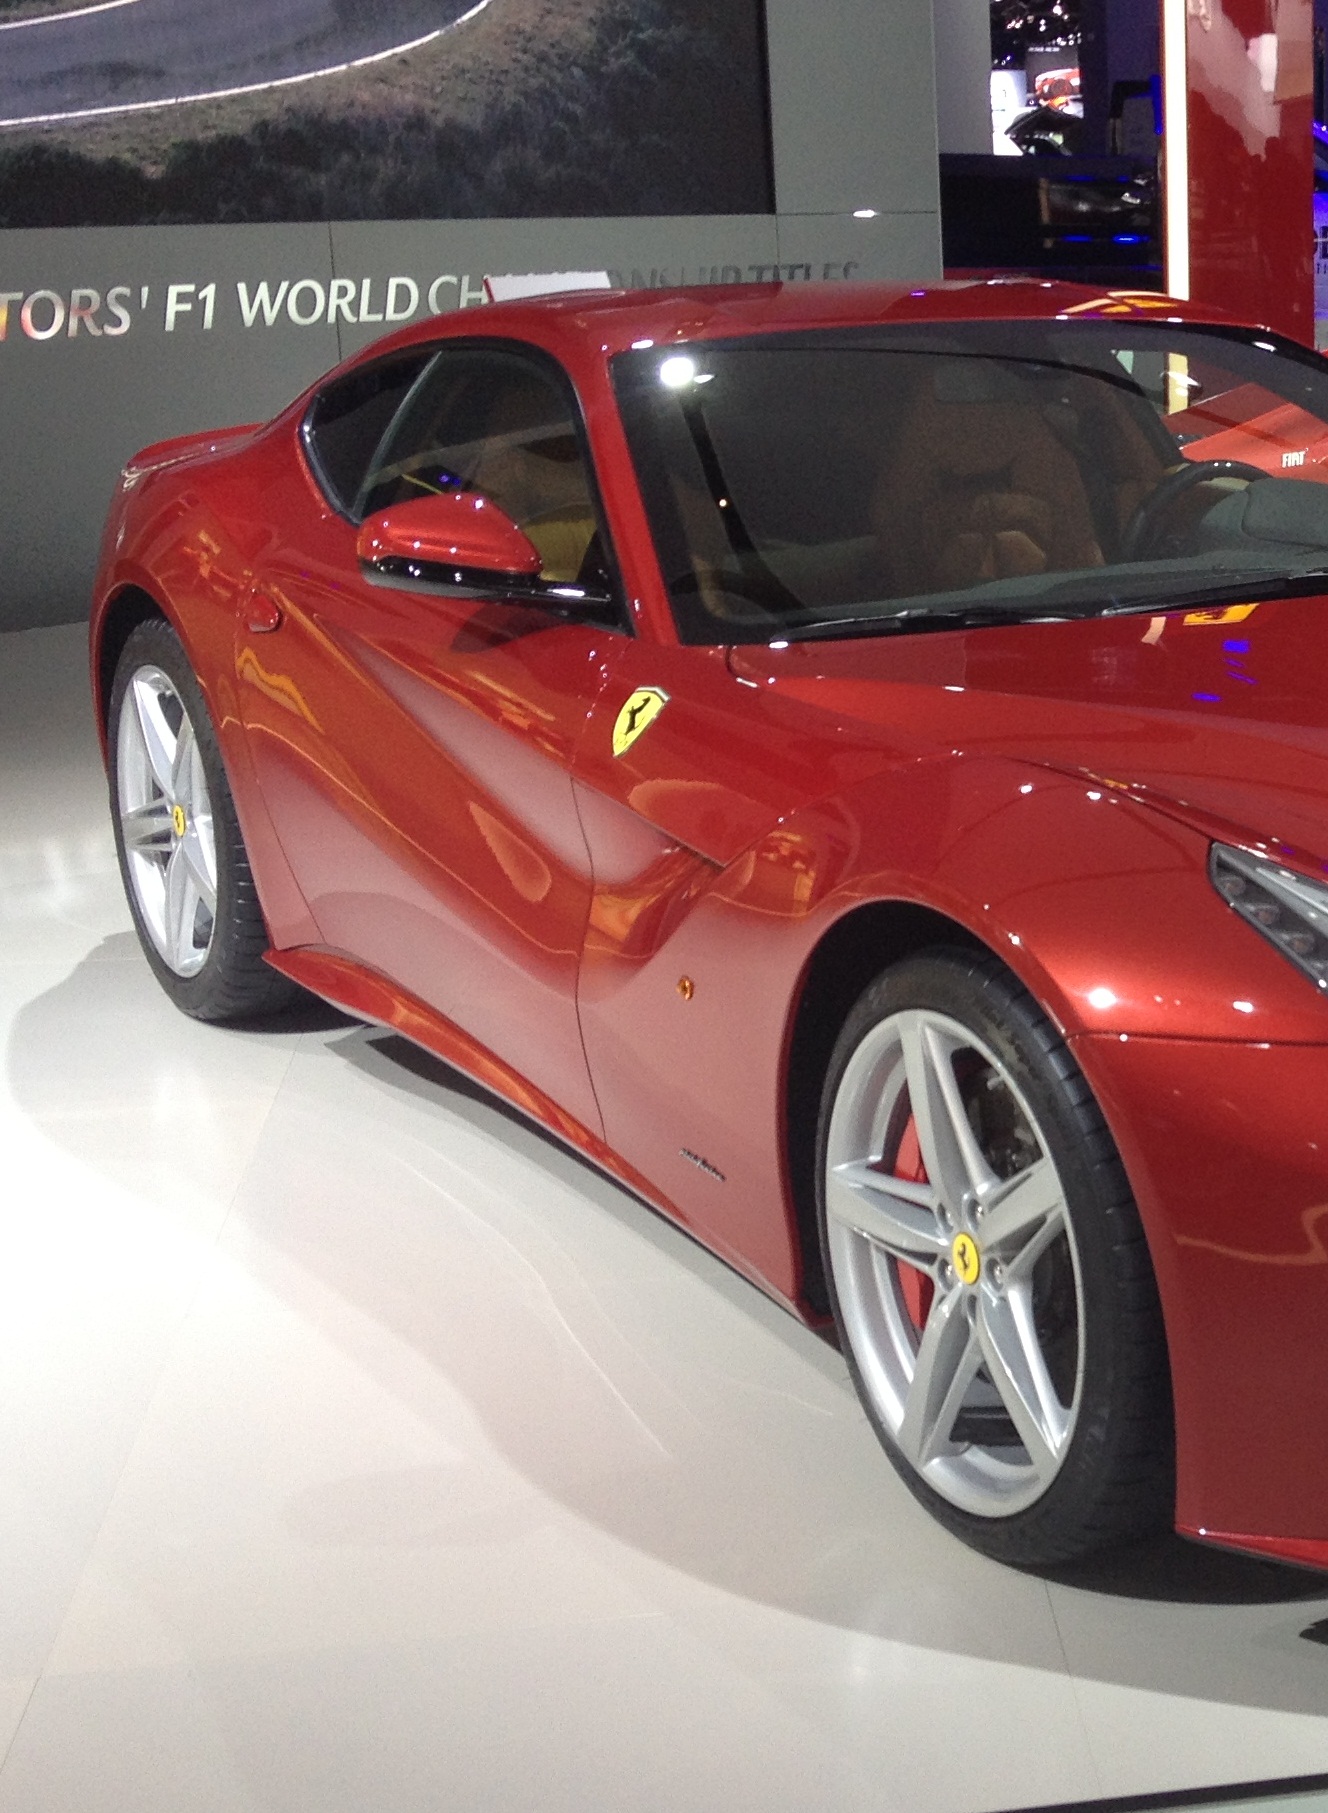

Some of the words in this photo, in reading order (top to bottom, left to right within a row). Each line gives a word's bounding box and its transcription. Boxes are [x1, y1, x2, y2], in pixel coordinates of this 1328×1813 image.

[165, 283, 217, 332] F1
[238, 276, 420, 327] WORLD
[1282, 450, 1305, 468] FIAT
